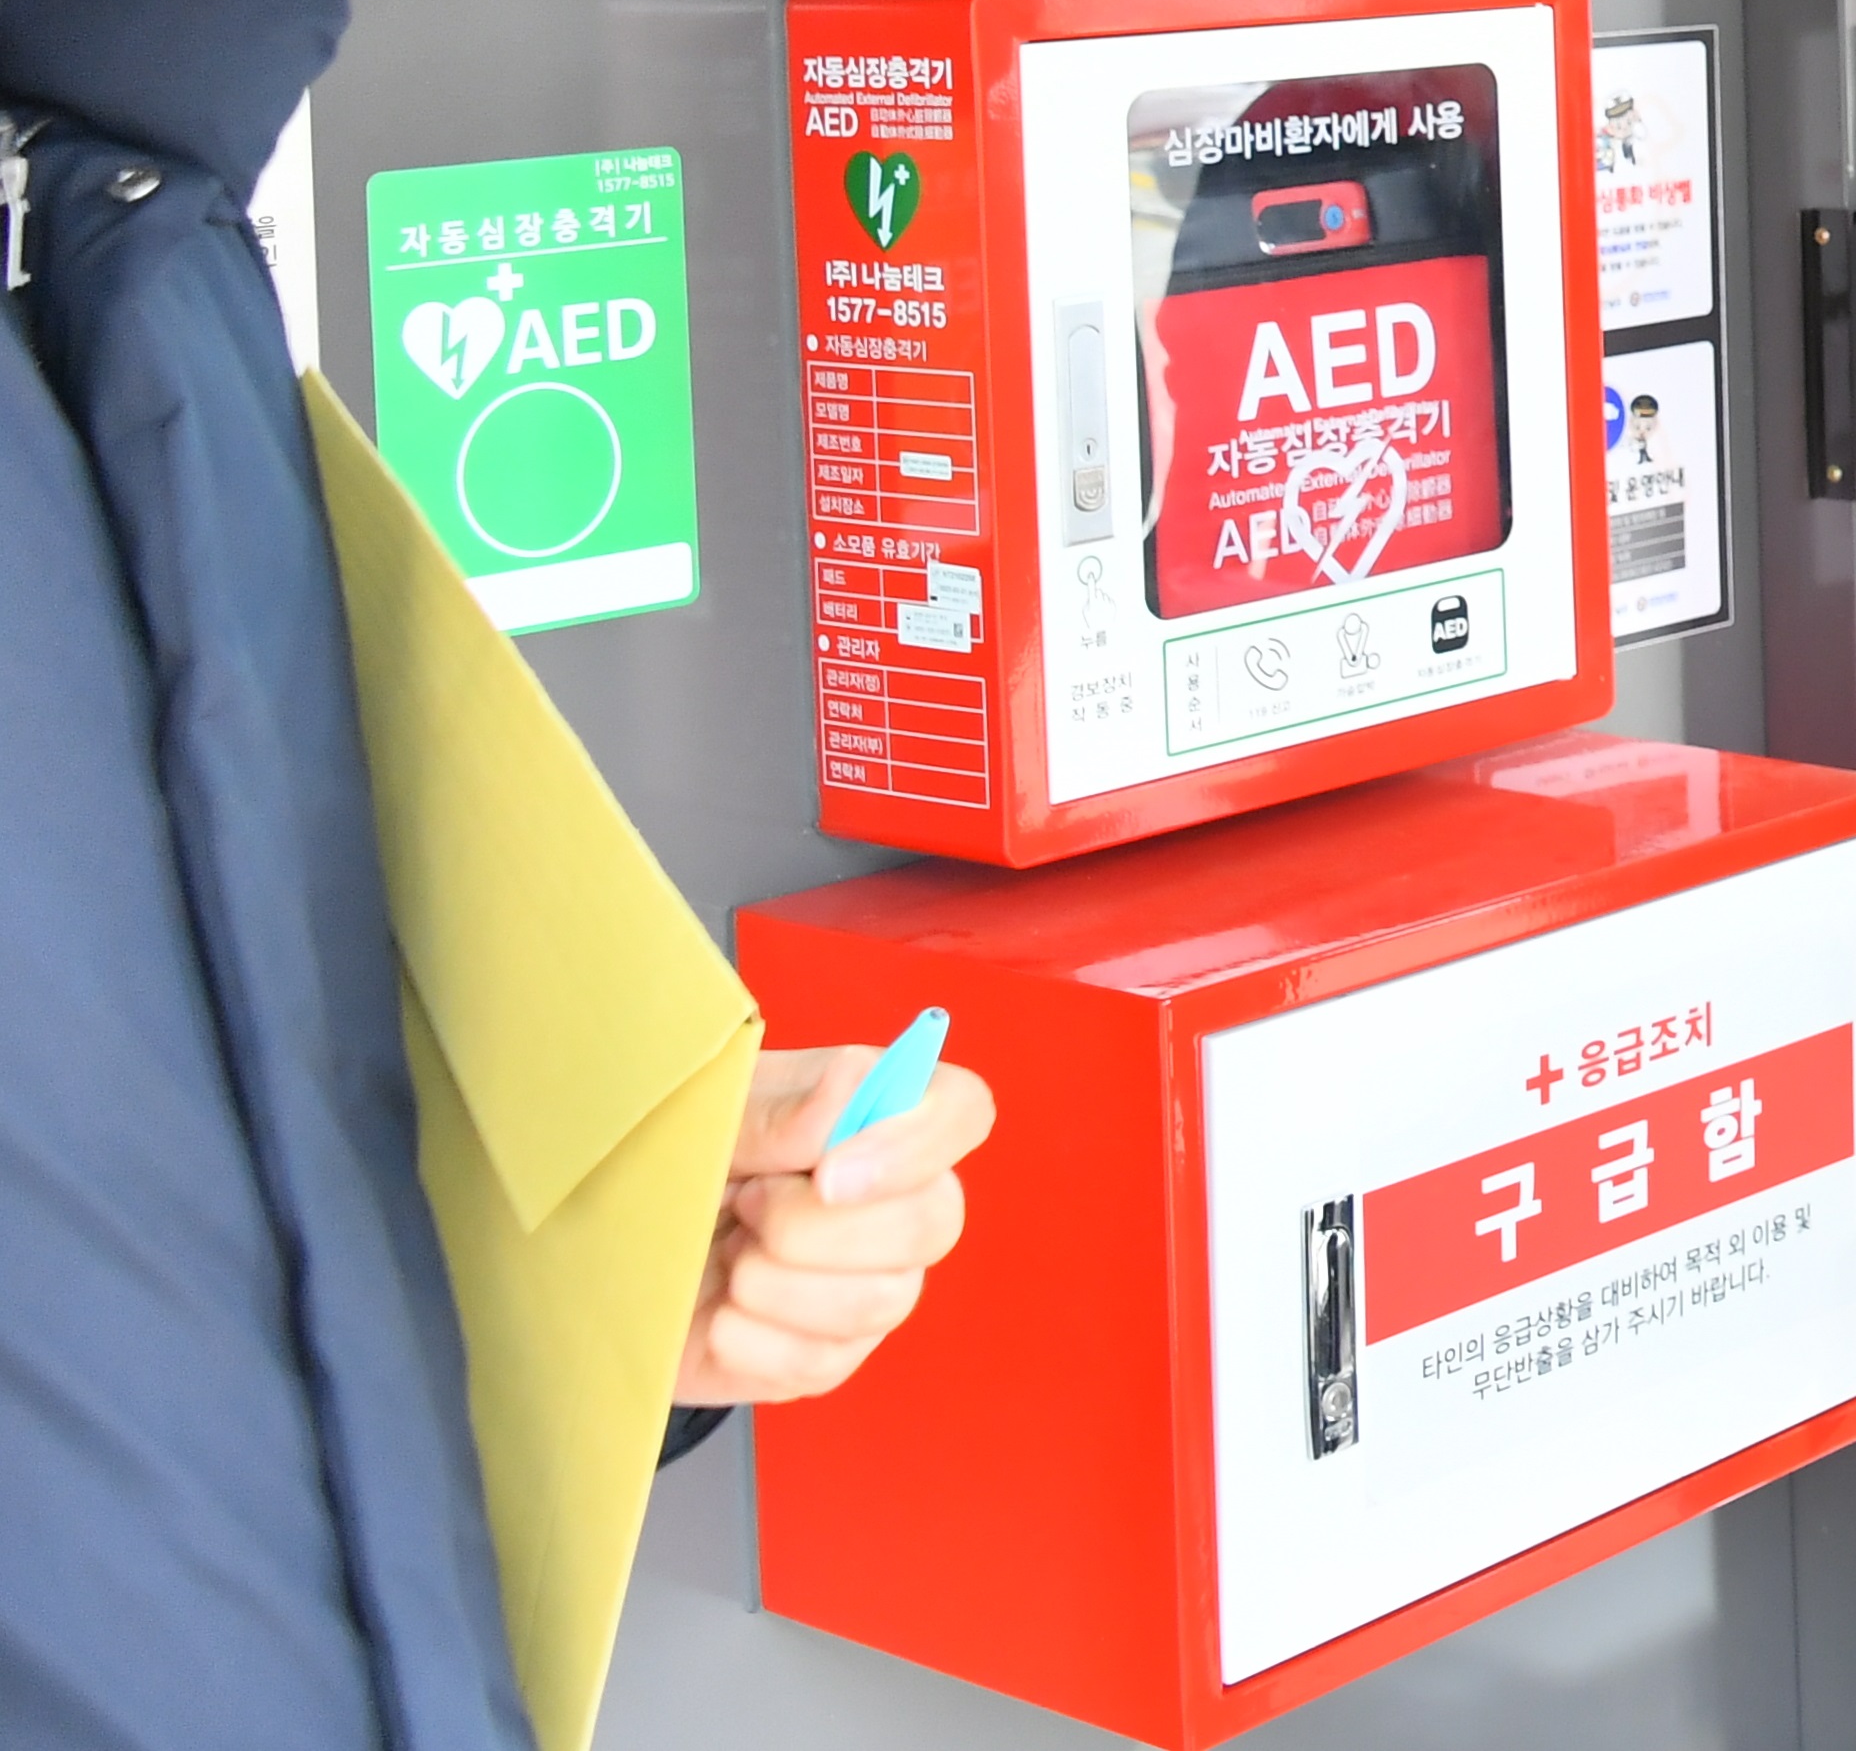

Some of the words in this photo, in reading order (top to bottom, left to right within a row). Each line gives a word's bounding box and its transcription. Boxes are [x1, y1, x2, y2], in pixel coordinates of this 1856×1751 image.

[803, 55, 953, 90] 자동심장충격기
[805, 107, 859, 138] AED
[1164, 107, 1399, 167] 심장마비환자에게
[1407, 100, 1465, 142] 사용
[597, 173, 676, 193] 1577-8515
[1597, 186, 1643, 214] 심통화
[1649, 179, 1692, 206] 비상벨
[400, 200, 653, 258] 자동심장충격기
[861, 261, 945, 293] 나눔테크
[826, 295, 948, 329] 1577-8515
[506, 297, 657, 375] AED
[825, 334, 928, 363] 자동심장충격기
[1237, 302, 1437, 422] AED
[1206, 399, 1451, 479] 자동심장충격기
[1627, 467, 1684, 501] 운영안내
[833, 533, 876, 559] 소모품
[1213, 506, 1312, 569] AED
[837, 635, 881, 661] 관리자
[1433, 618, 1469, 643] AED
[1071, 671, 1133, 703] 경보장치
[1577, 1000, 1713, 1090] 응급조치
[1474, 1077, 1763, 1263] 구급함
[1422, 1333, 1485, 1381] 타인의
[1492, 1291, 1594, 1355] 응급상황을
[1600, 1256, 1678, 1307] 대비하여
[1684, 1239, 1721, 1274] 목적
[1728, 1229, 1746, 1256] 외
[1752, 1214, 1787, 1247] 이용
[1795, 1204, 1812, 1234] 및
[1472, 1335, 1574, 1400] 무단반출을
[1581, 1317, 1620, 1357] 삼가
[1627, 1290, 1684, 1336] 주시기
[1690, 1258, 1770, 1308] 바랍니다.
